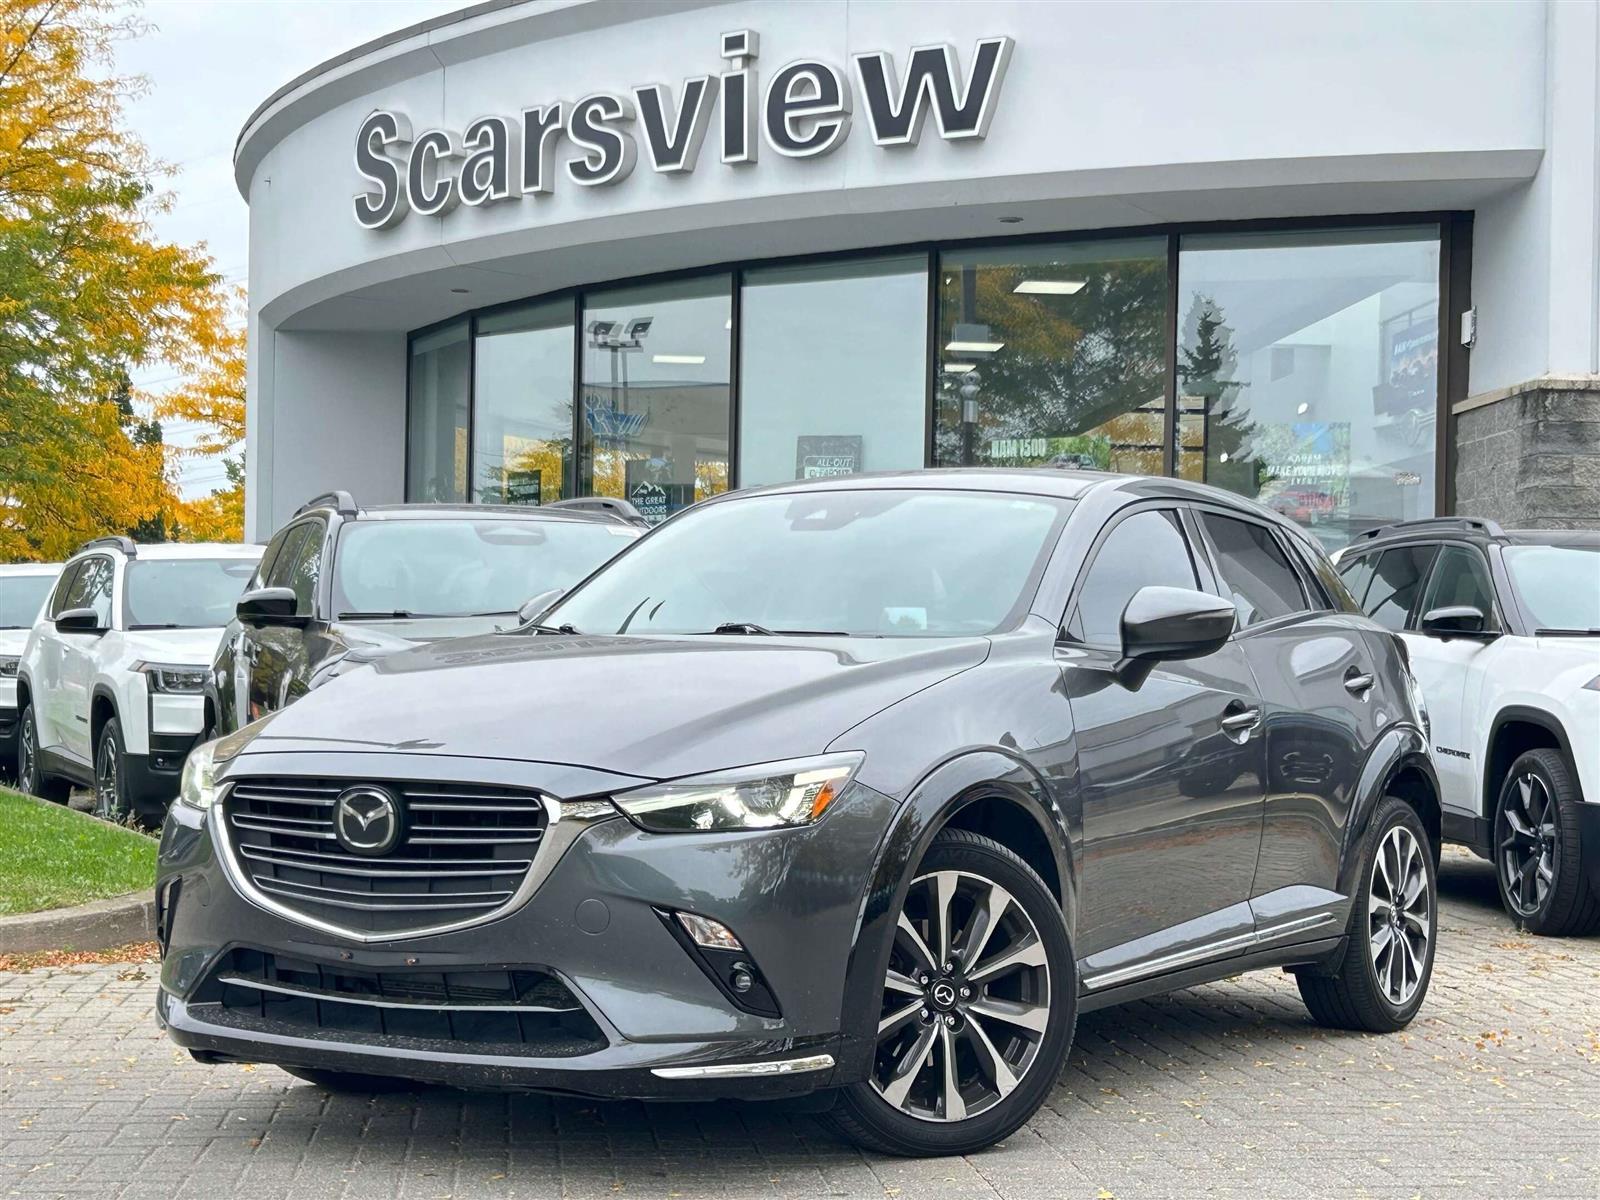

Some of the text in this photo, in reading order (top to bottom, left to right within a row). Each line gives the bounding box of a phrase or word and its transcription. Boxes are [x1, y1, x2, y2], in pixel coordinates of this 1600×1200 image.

[352, 29, 1014, 231] Scarsview
[1019, 438, 1047, 458] 1500
[645, 496, 667, 505] GREAT
